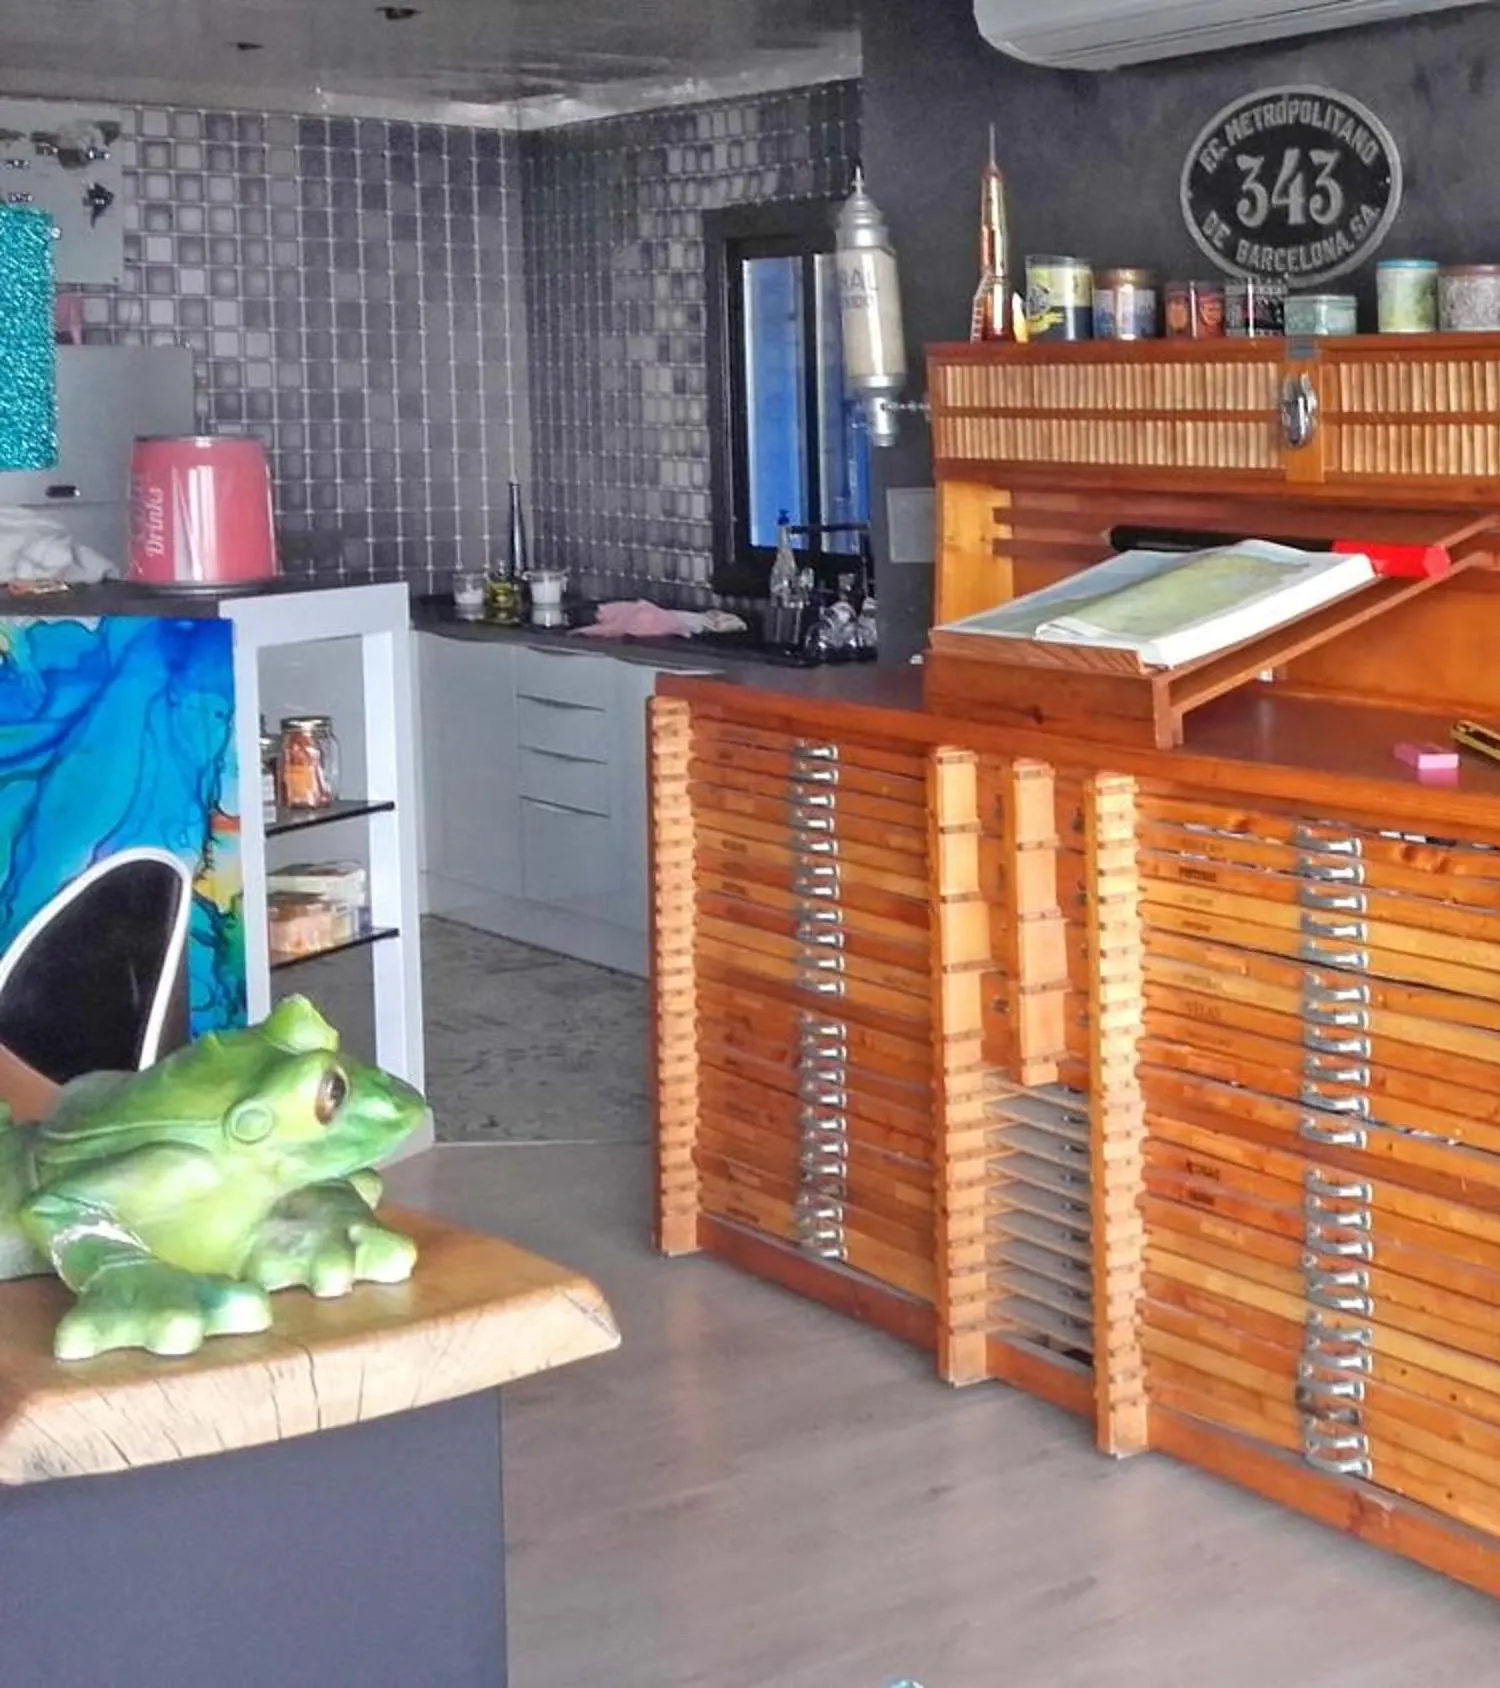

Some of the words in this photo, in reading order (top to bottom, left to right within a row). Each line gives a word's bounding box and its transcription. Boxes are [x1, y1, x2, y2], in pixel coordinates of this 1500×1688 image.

[1224, 100, 1379, 165] METROPOLITANO
[1235, 147, 1344, 228] 343
[1201, 210, 1231, 250] DE
